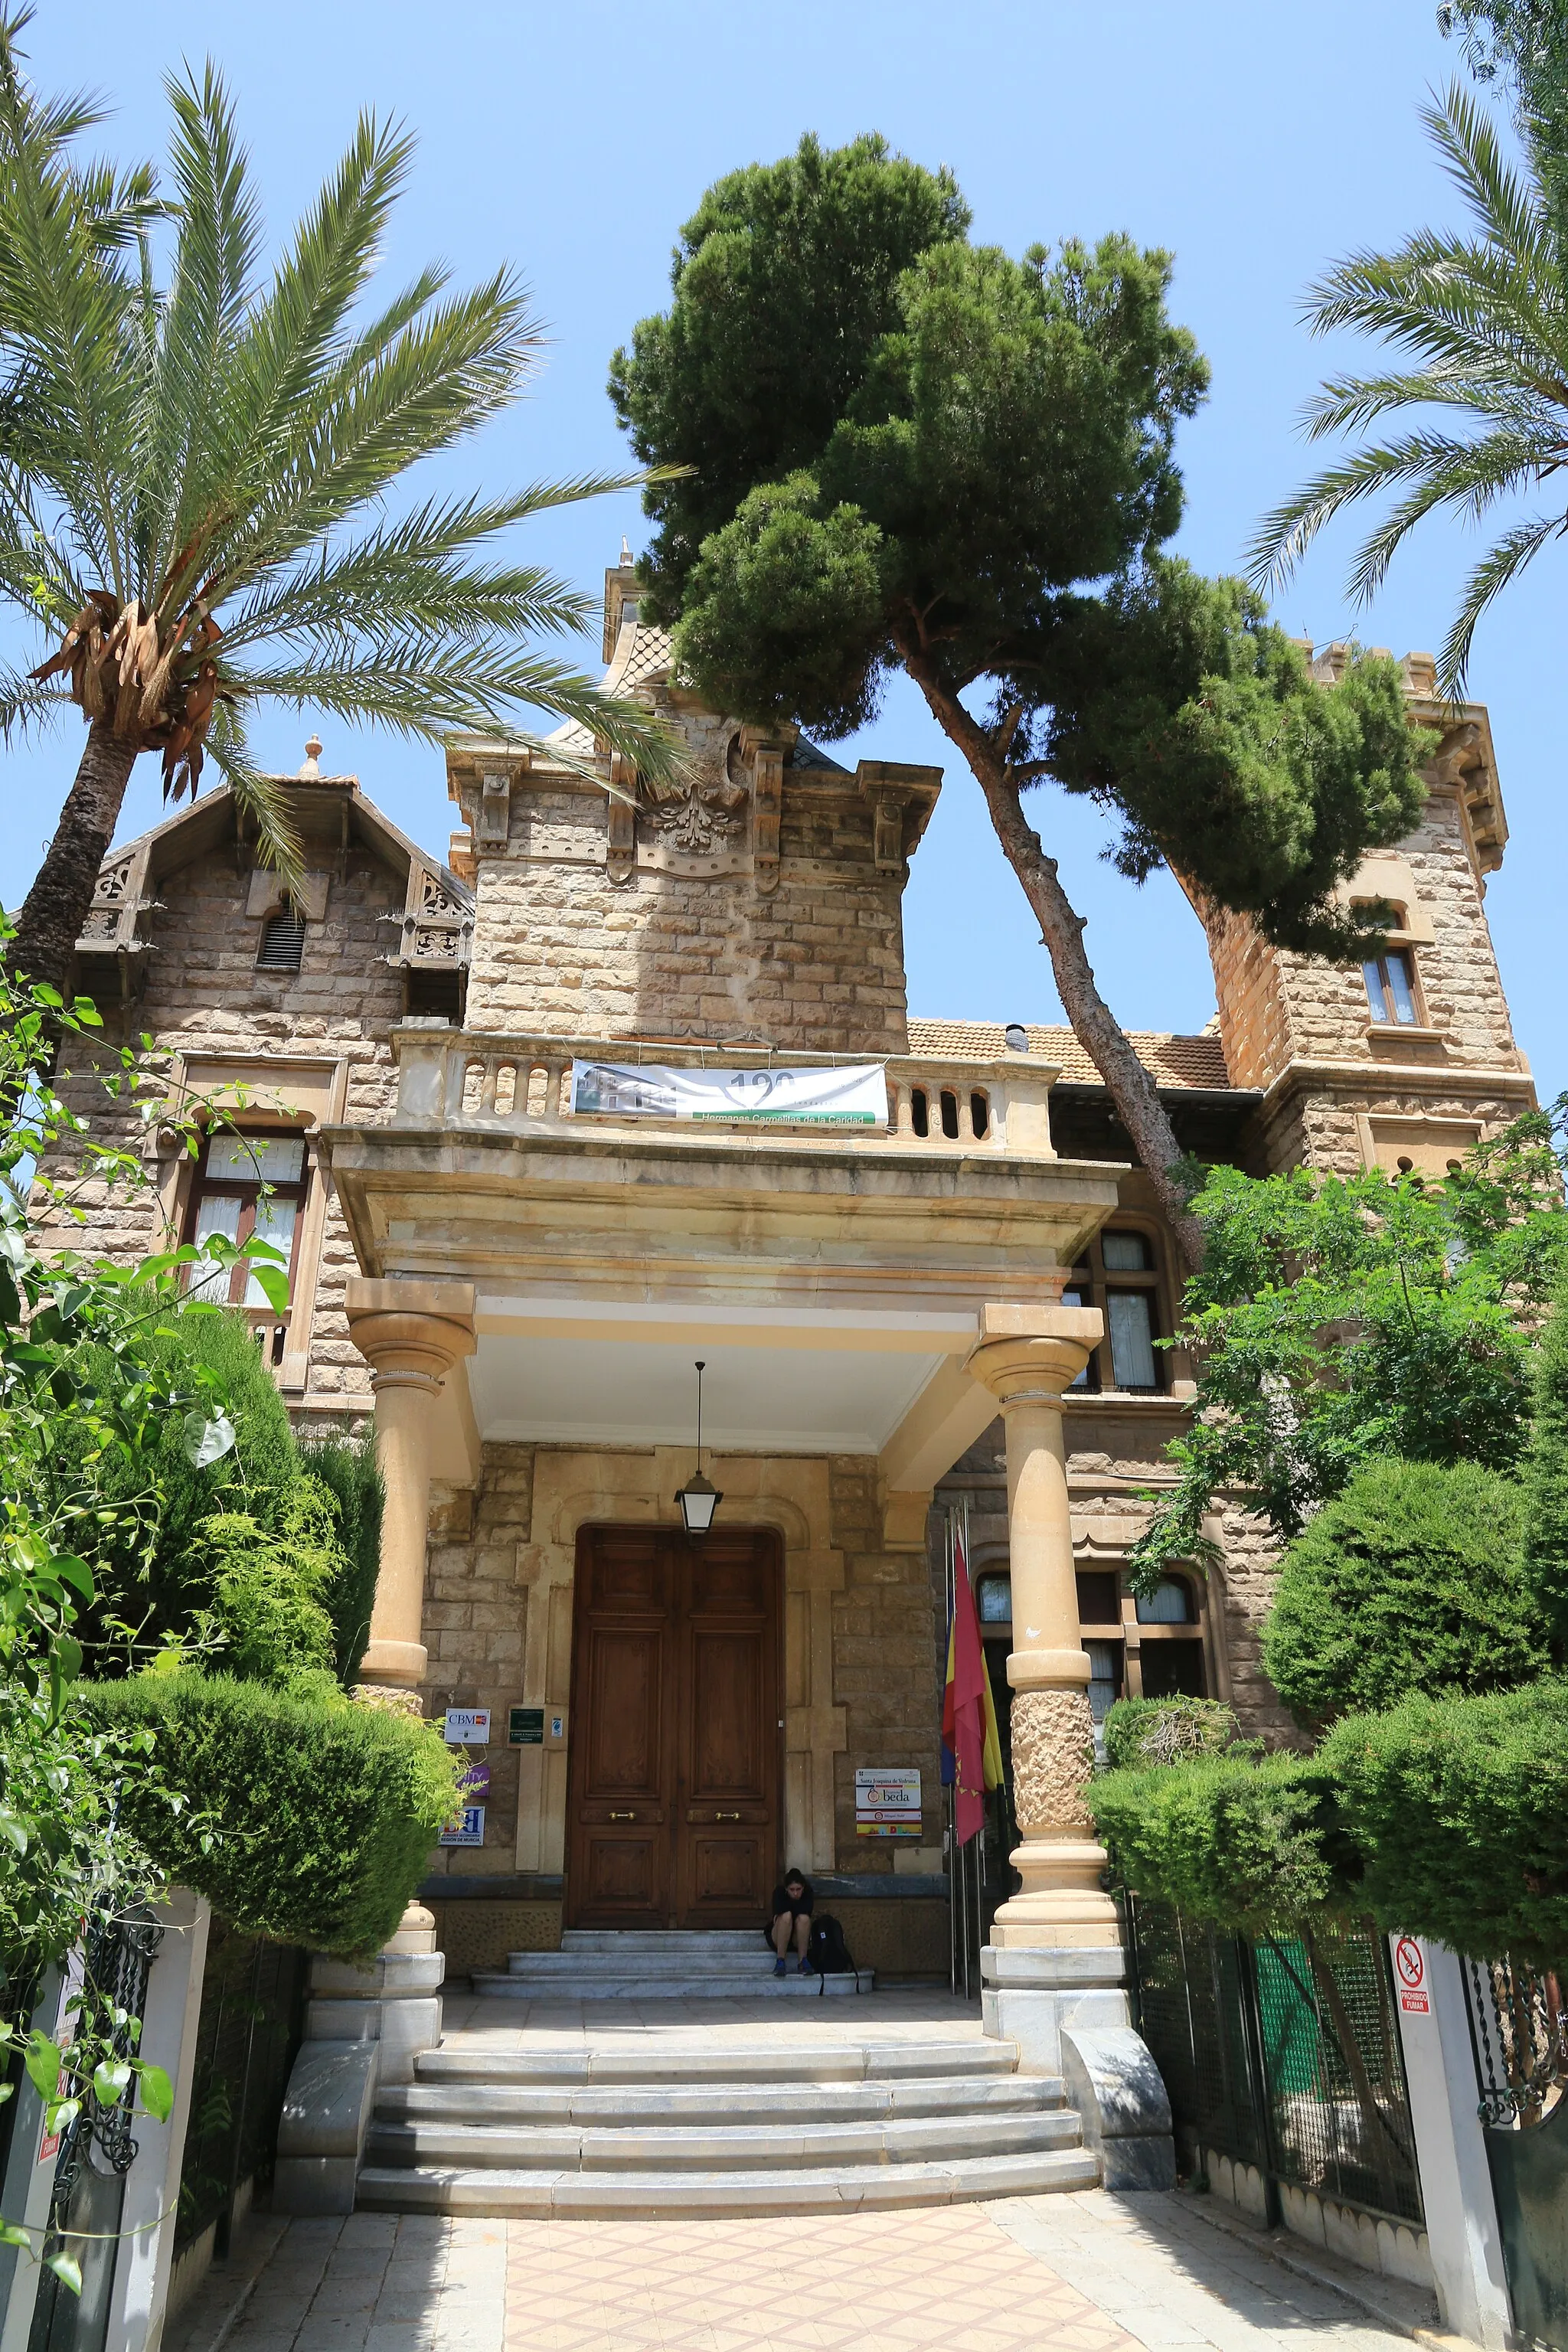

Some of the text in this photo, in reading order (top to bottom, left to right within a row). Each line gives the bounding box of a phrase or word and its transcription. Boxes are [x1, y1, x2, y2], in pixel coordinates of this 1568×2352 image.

[753, 1114, 801, 1122] Carmelitas
[804, 1115, 815, 1123] de
[828, 1115, 864, 1124] Caridad
[449, 1714, 475, 1724] CBM
[1401, 1991, 1427, 2001] PROHIBIDO
[1406, 2001, 1424, 2010] FUMAR
